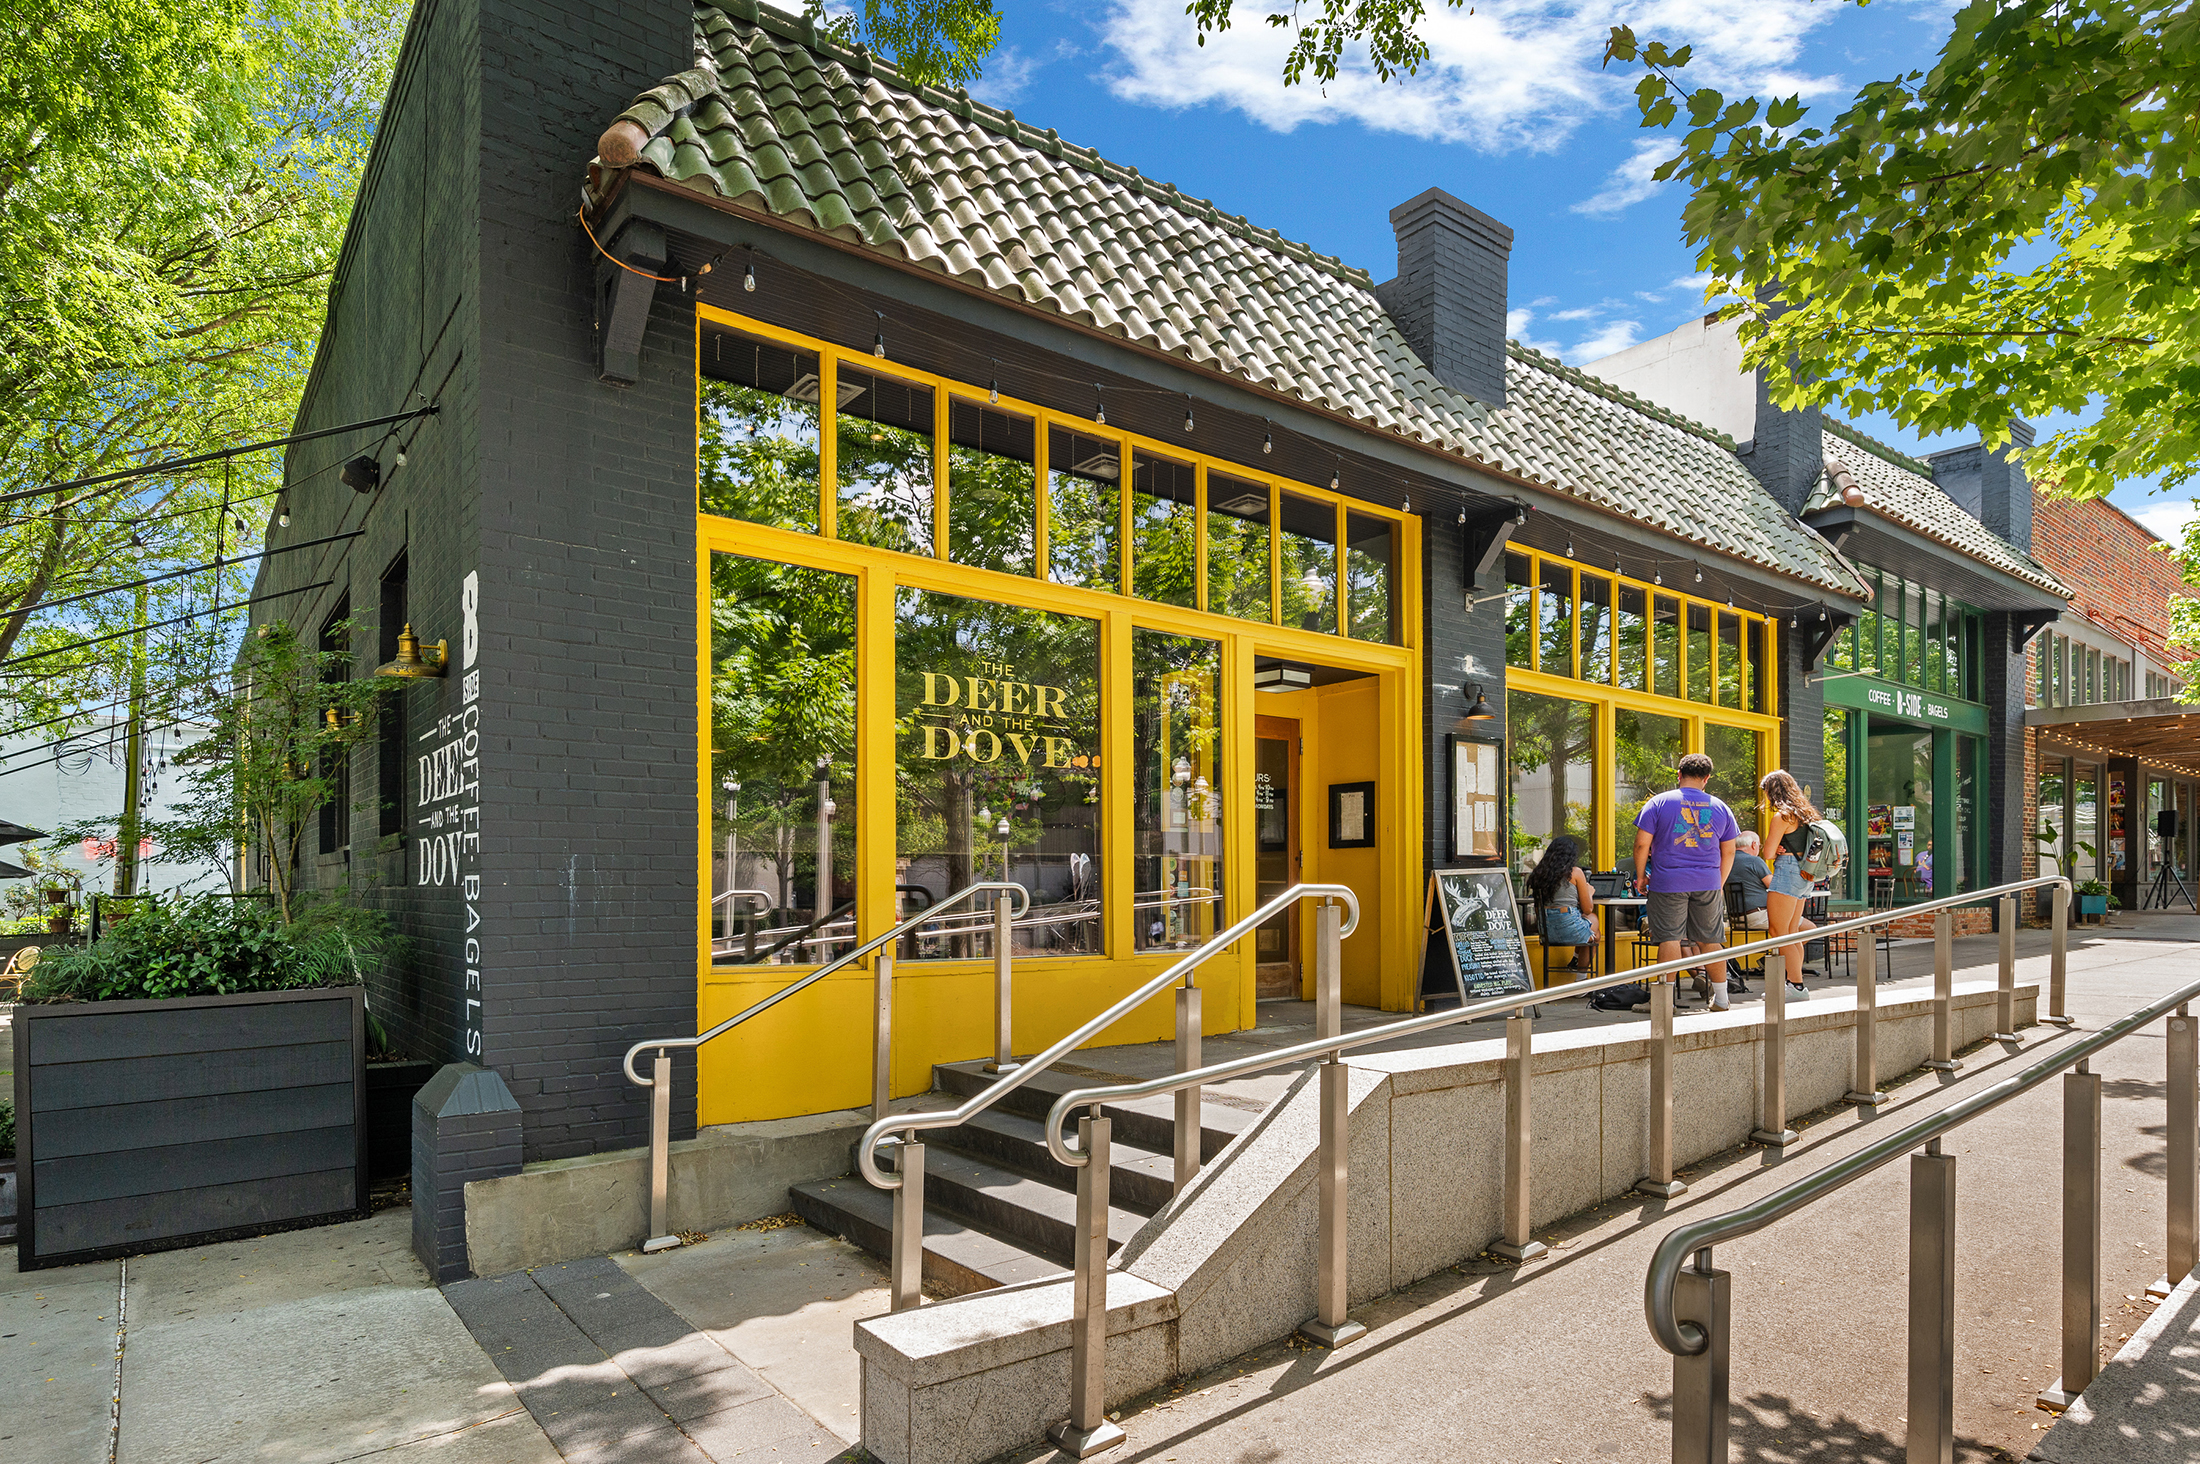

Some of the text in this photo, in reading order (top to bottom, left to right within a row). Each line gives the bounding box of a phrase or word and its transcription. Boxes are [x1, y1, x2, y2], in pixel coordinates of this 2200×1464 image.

[462, 570, 479, 702] B SIDE
[981, 661, 1015, 677] THE
[920, 671, 1069, 718] DEER
[1868, 689, 1948, 719] COFFEE B-SIDE BAGELS
[438, 714, 451, 739] THE
[959, 712, 1034, 731] AND THE
[920, 725, 1072, 769] DOVE
[431, 804, 459, 829] AND THE
[418, 831, 464, 886] DOV
[463, 704, 481, 1056] COFFEE BAGELS
[1485, 909, 1509, 920] DEER
[1486, 921, 1512, 931] DOVE
